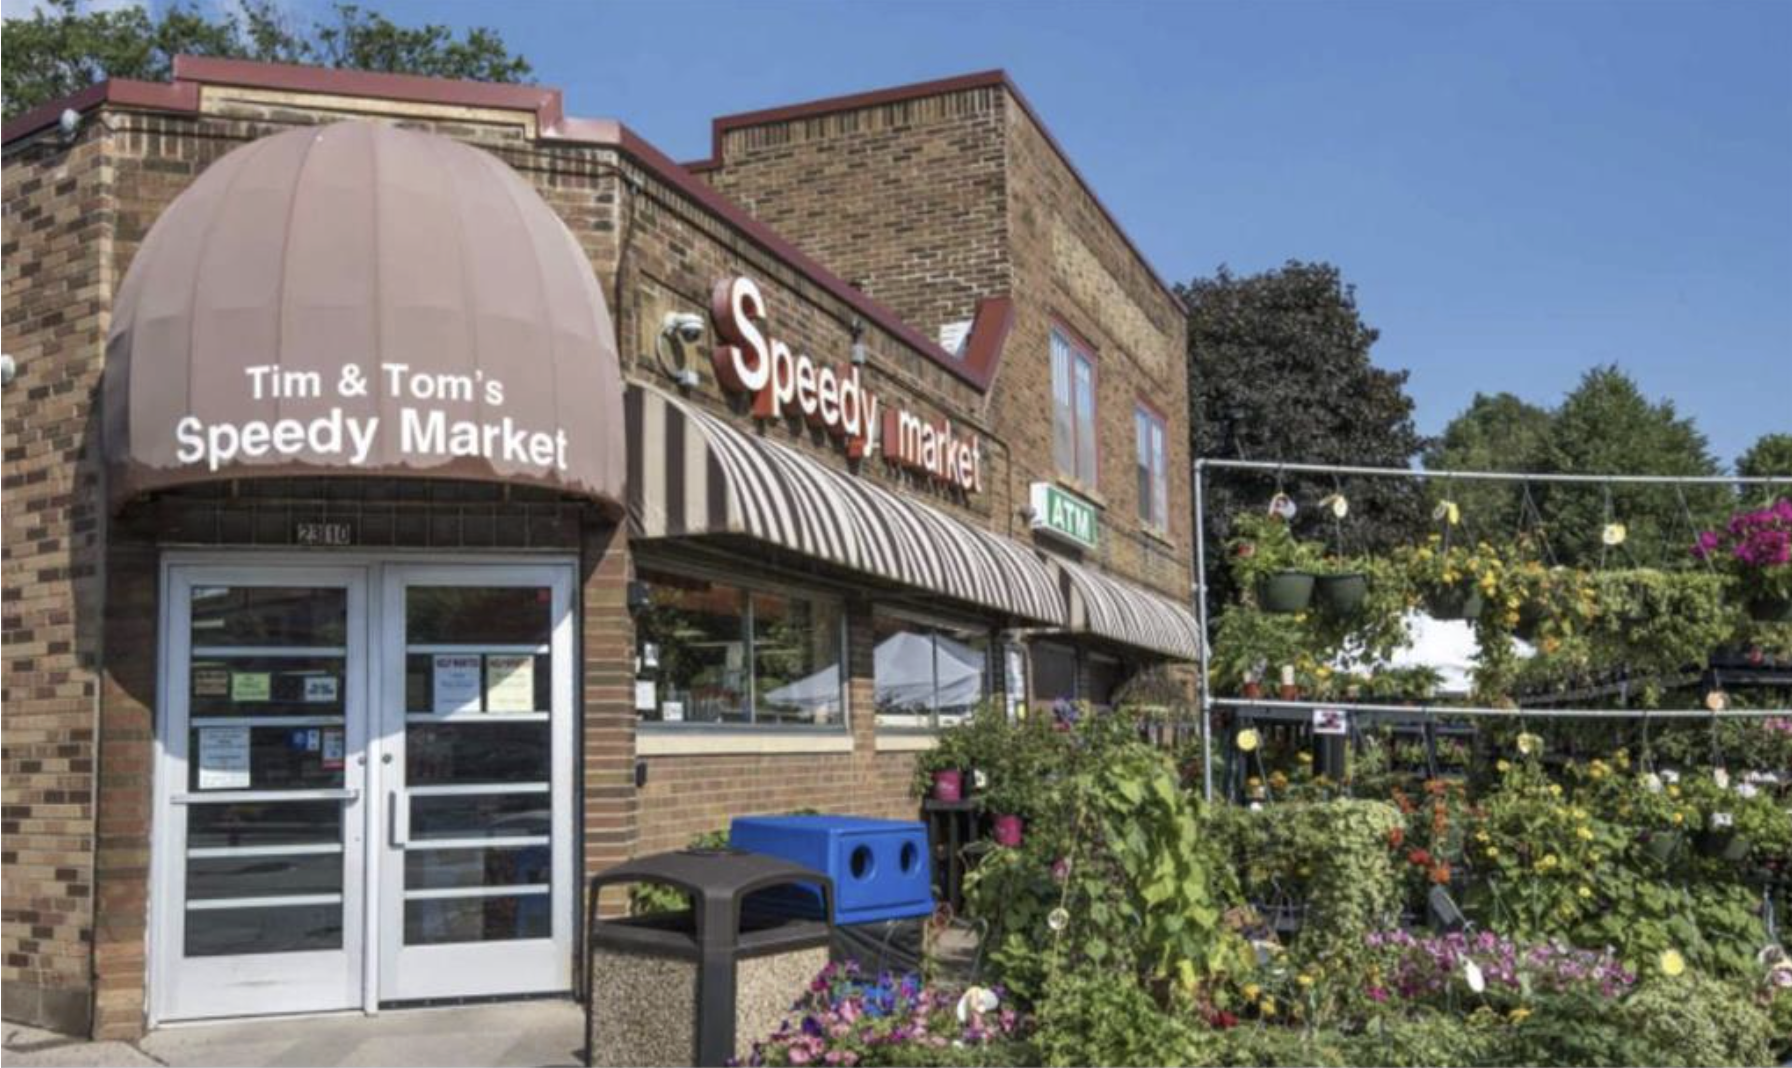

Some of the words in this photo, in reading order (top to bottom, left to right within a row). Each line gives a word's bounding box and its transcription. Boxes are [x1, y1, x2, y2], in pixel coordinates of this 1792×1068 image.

[246, 365, 321, 400] Tim
[338, 363, 368, 397] &
[382, 362, 505, 406] Tom's
[731, 276, 877, 458] Speedy
[898, 409, 982, 493] market
[176, 407, 380, 471] Speedy
[401, 407, 569, 470] Market
[1051, 495, 1090, 542] ATM
